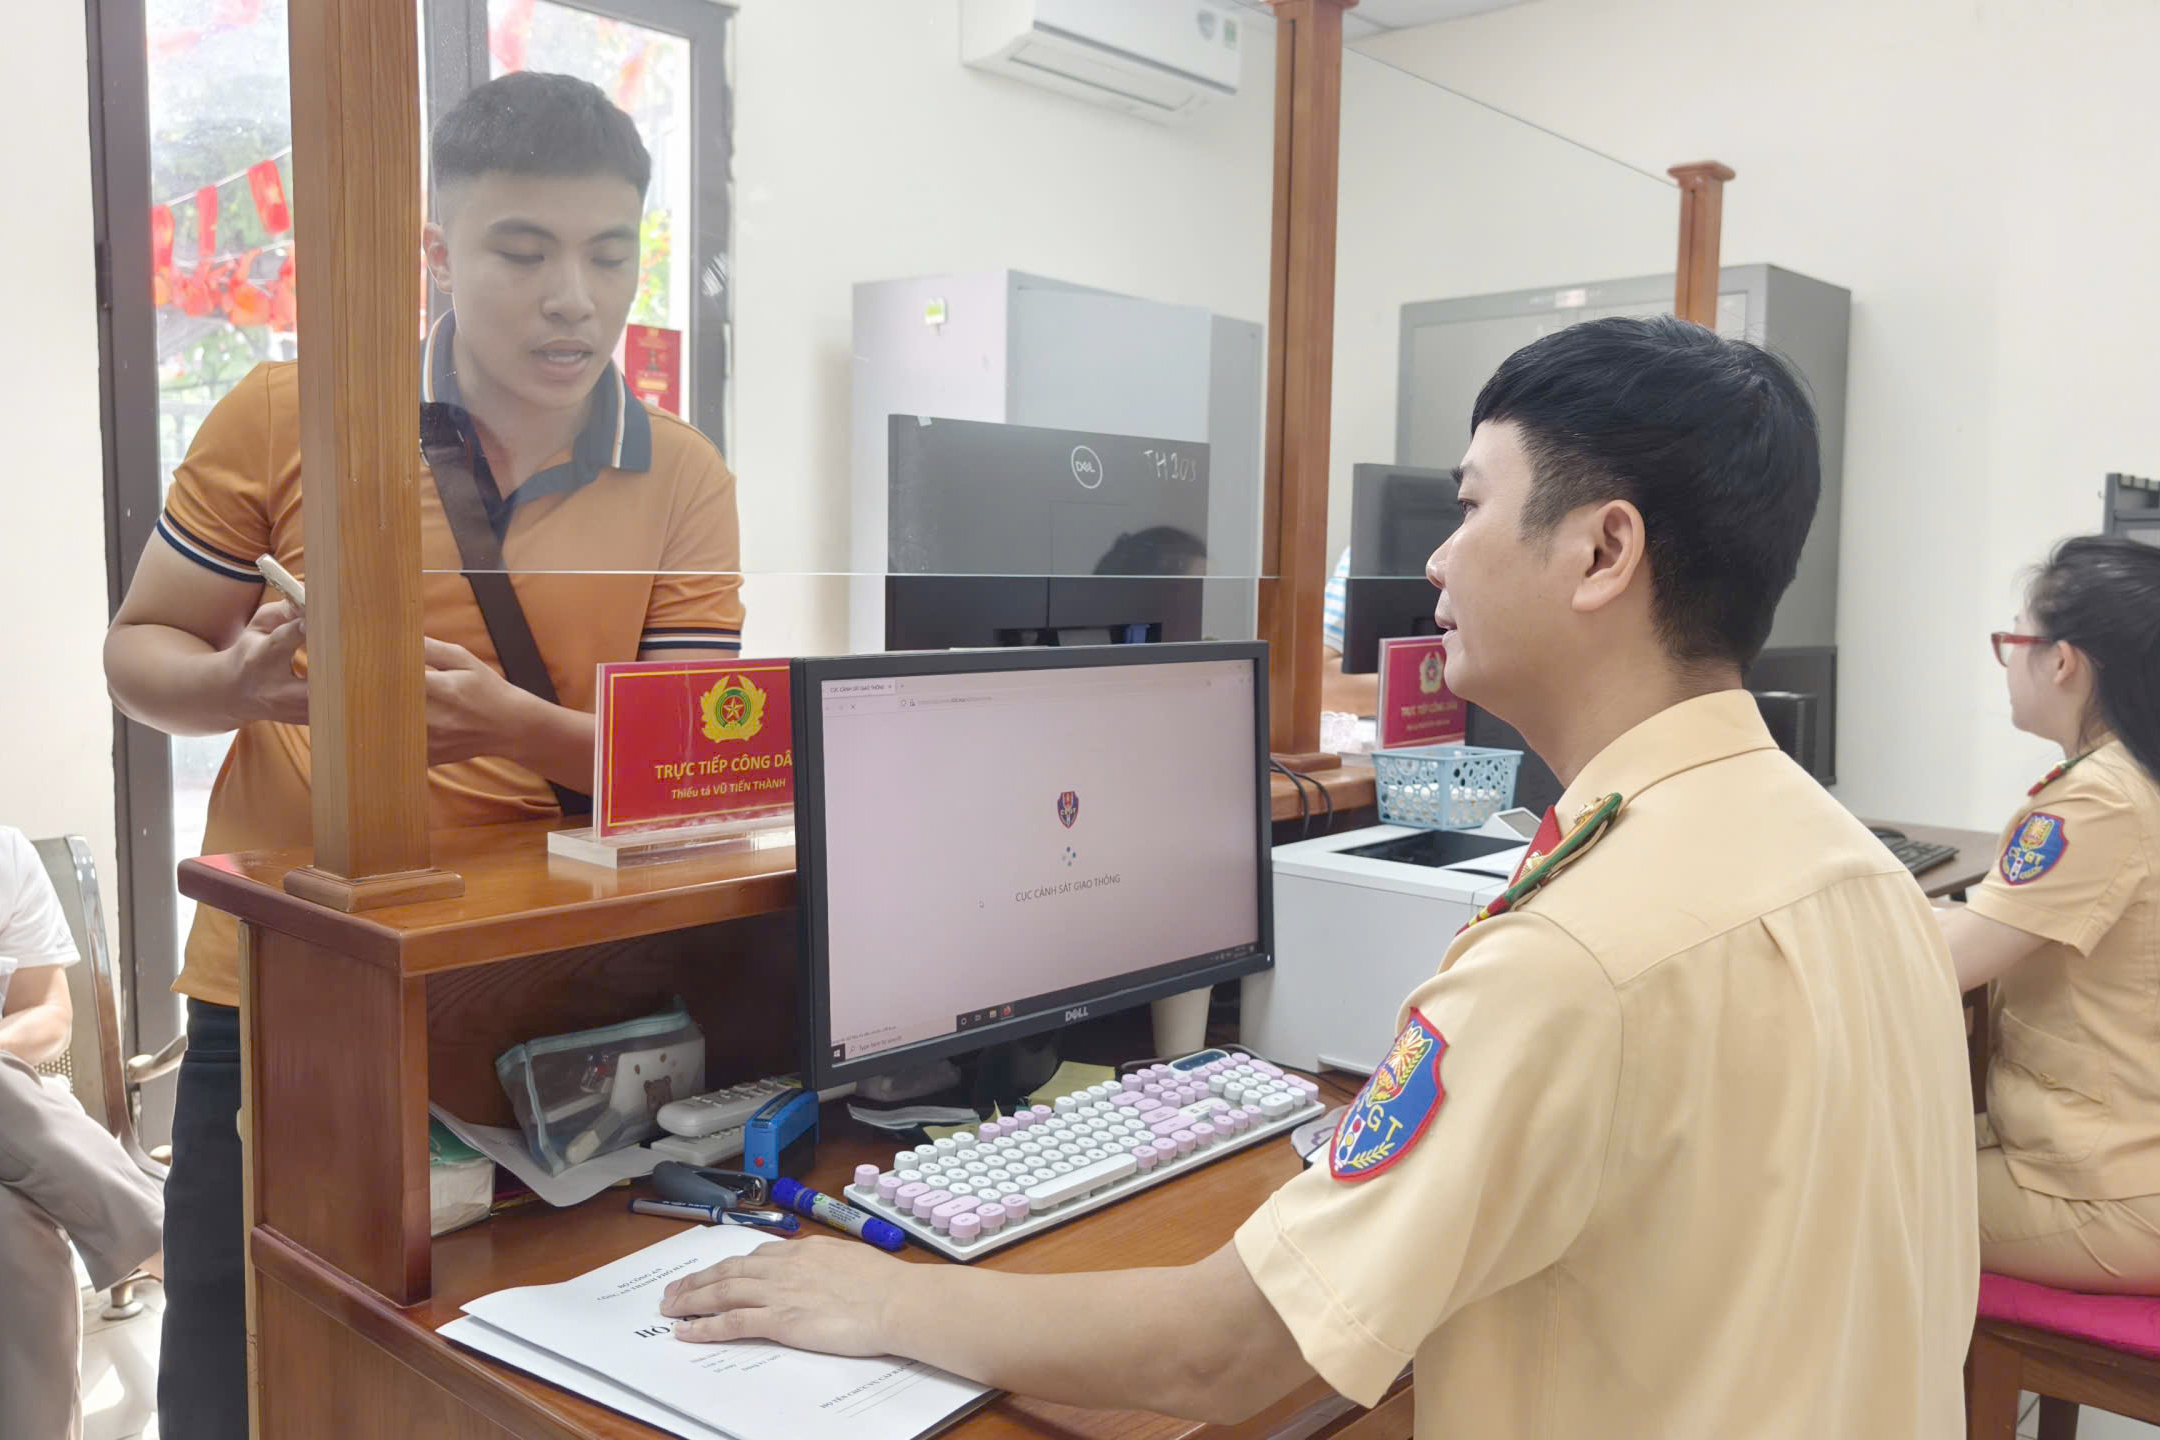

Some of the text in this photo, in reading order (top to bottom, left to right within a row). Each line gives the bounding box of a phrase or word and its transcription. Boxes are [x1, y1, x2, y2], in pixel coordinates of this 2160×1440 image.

[654, 749, 793, 780] TRỰC TIẾP CÔNG DÂ
[671, 777, 786, 799] Thiếu tá VŨ TIẾN THÀNH
[1015, 873, 1121, 902] CỤC CẢNH SÁT GIAO THÔNG
[1065, 1006, 1089, 1022] DELL
